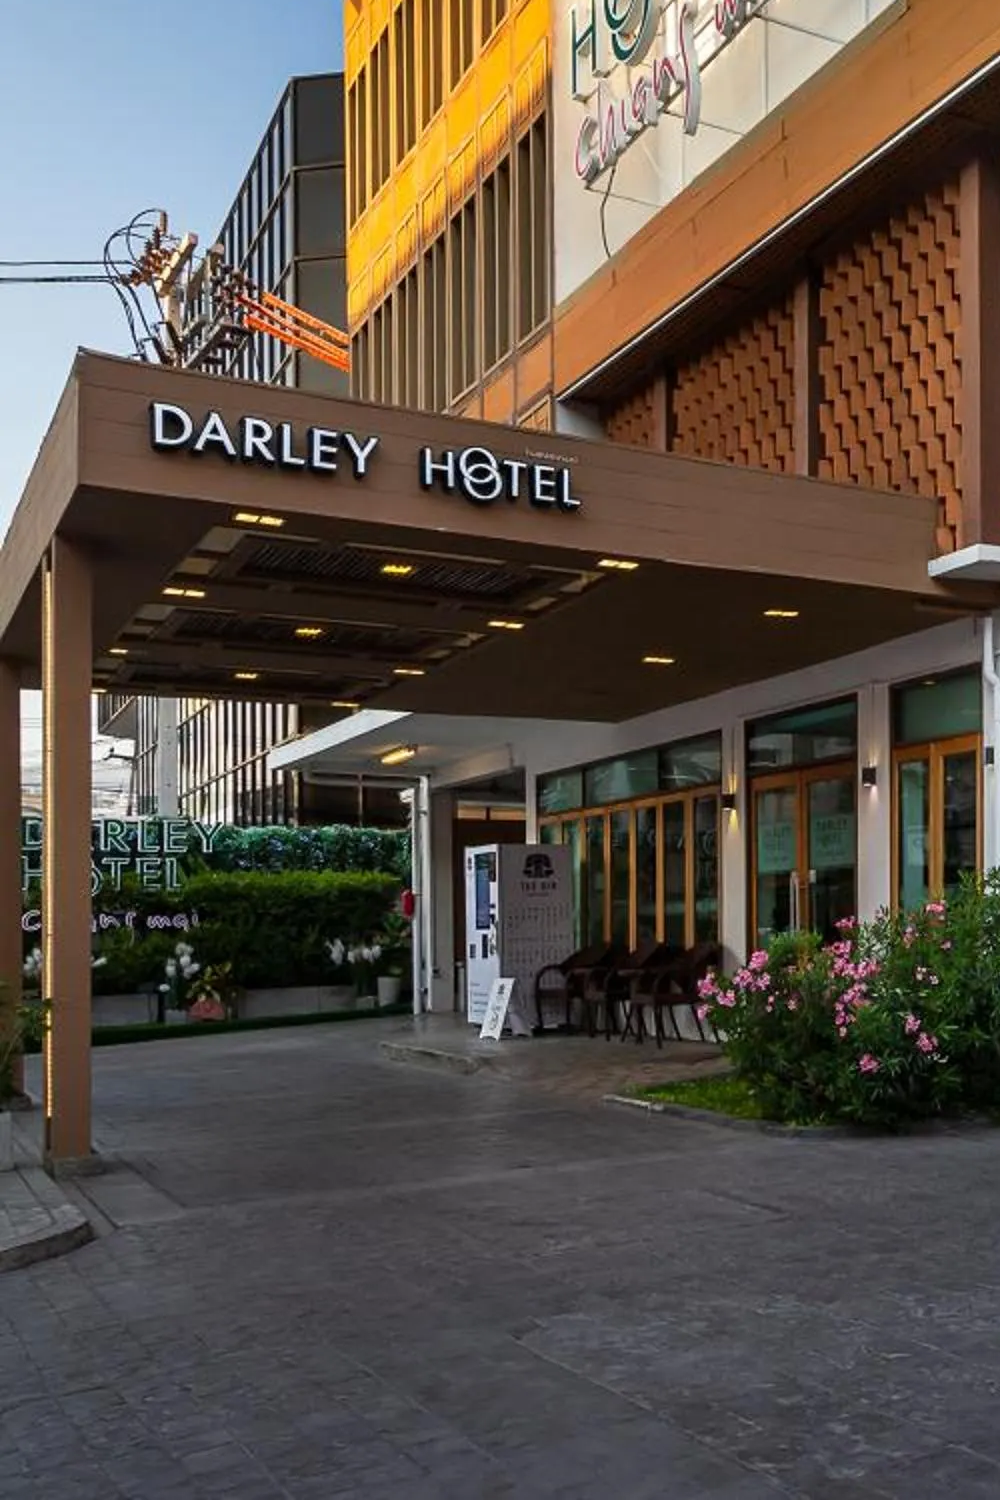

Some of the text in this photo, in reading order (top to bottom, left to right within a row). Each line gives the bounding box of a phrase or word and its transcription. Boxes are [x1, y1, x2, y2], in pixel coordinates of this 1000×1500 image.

[149, 401, 581, 510] DARLEY HOTEL
[22, 817, 223, 853] DRLEY
[22, 856, 183, 896] HTEL
